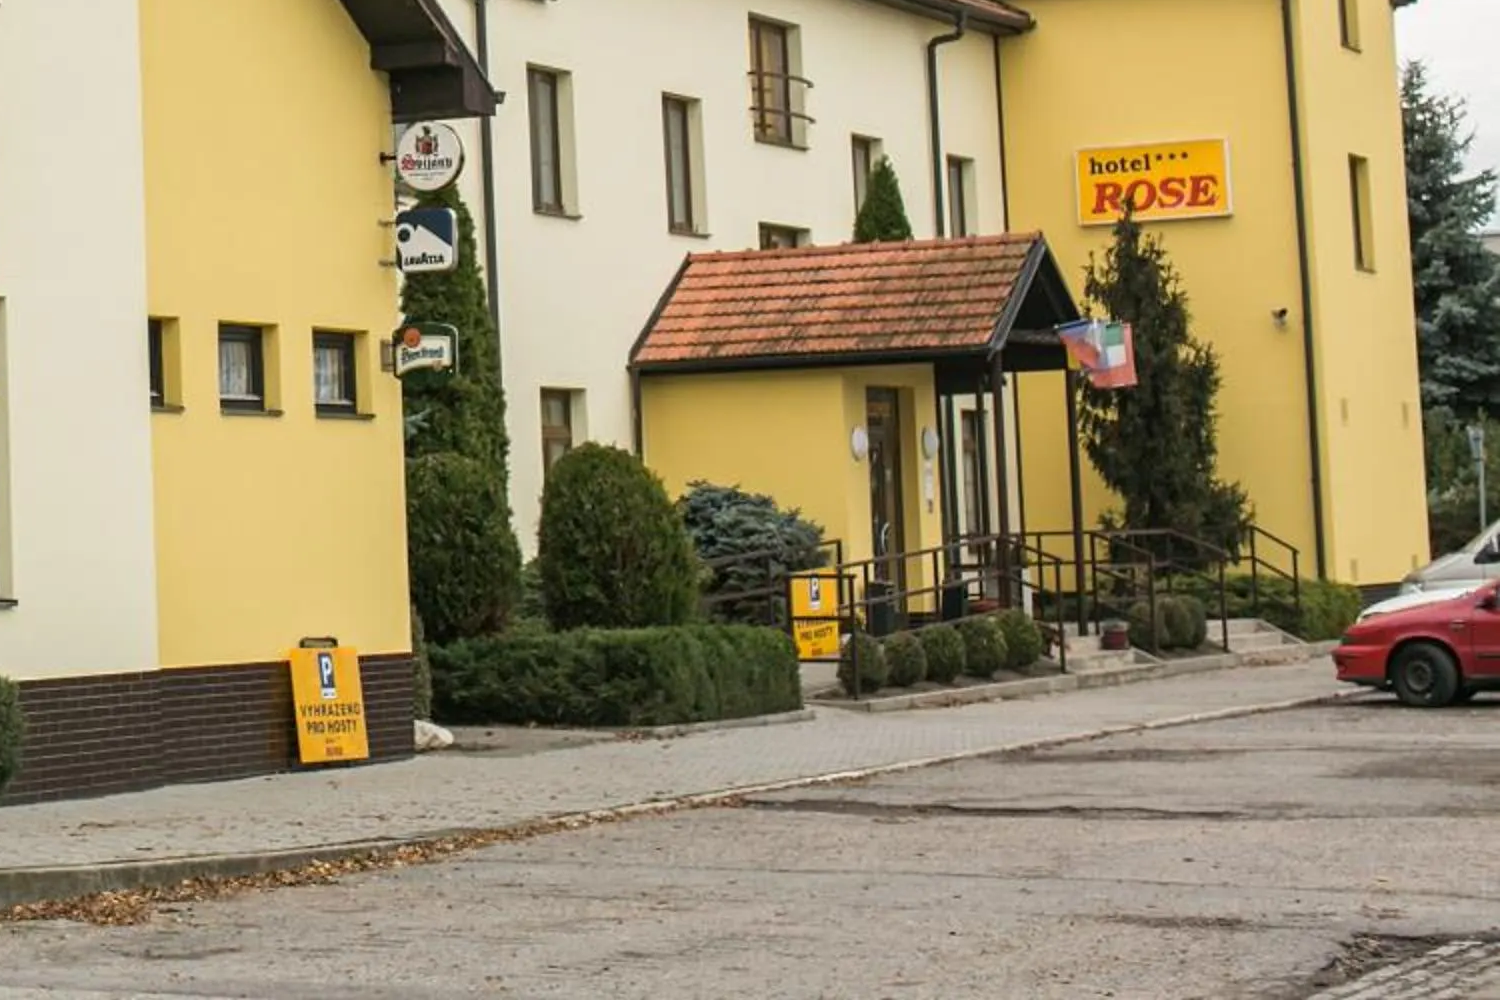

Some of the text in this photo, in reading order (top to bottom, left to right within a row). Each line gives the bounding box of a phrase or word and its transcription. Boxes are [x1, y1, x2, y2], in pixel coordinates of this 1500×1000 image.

[1089, 153, 1150, 175] hotel
[1092, 174, 1219, 214] ROSE
[321, 656, 332, 684] P
